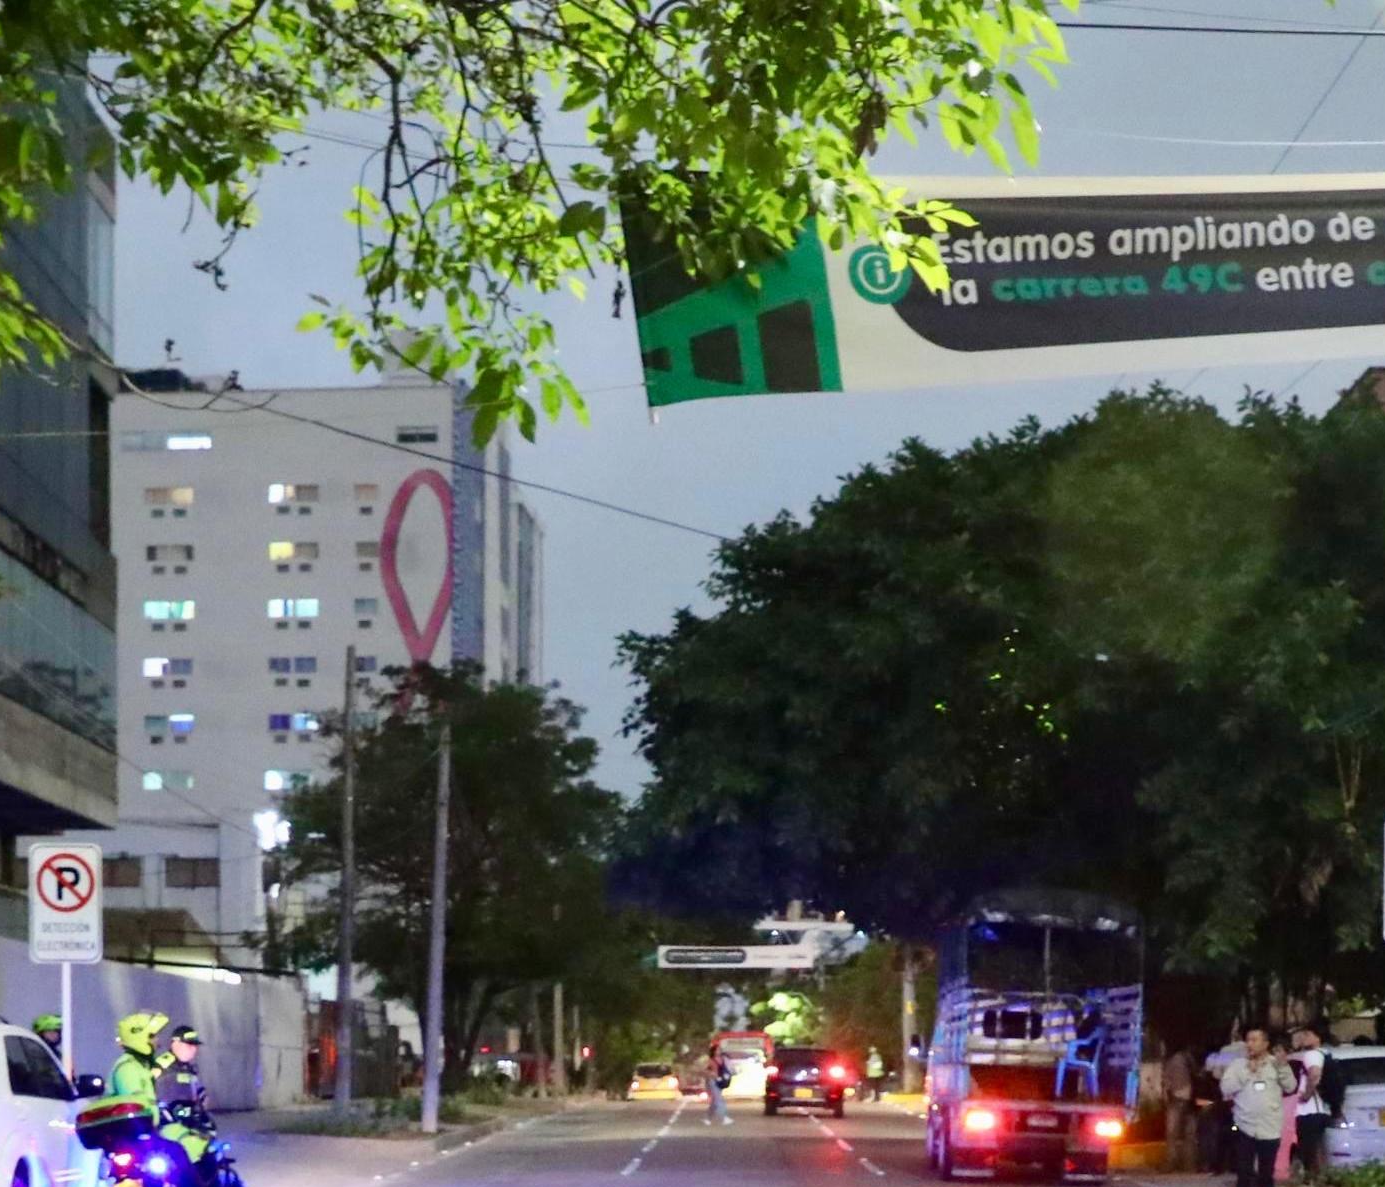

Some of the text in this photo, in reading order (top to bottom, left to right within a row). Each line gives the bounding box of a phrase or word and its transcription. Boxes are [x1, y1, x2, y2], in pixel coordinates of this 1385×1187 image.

[932, 230, 1095, 264] Estamos
[1109, 213, 1315, 262] ampliando
[1327, 211, 1375, 242] de
[991, 275, 1149, 301] carrera
[1161, 261, 1245, 294] 49C
[1255, 257, 1355, 292] entre
